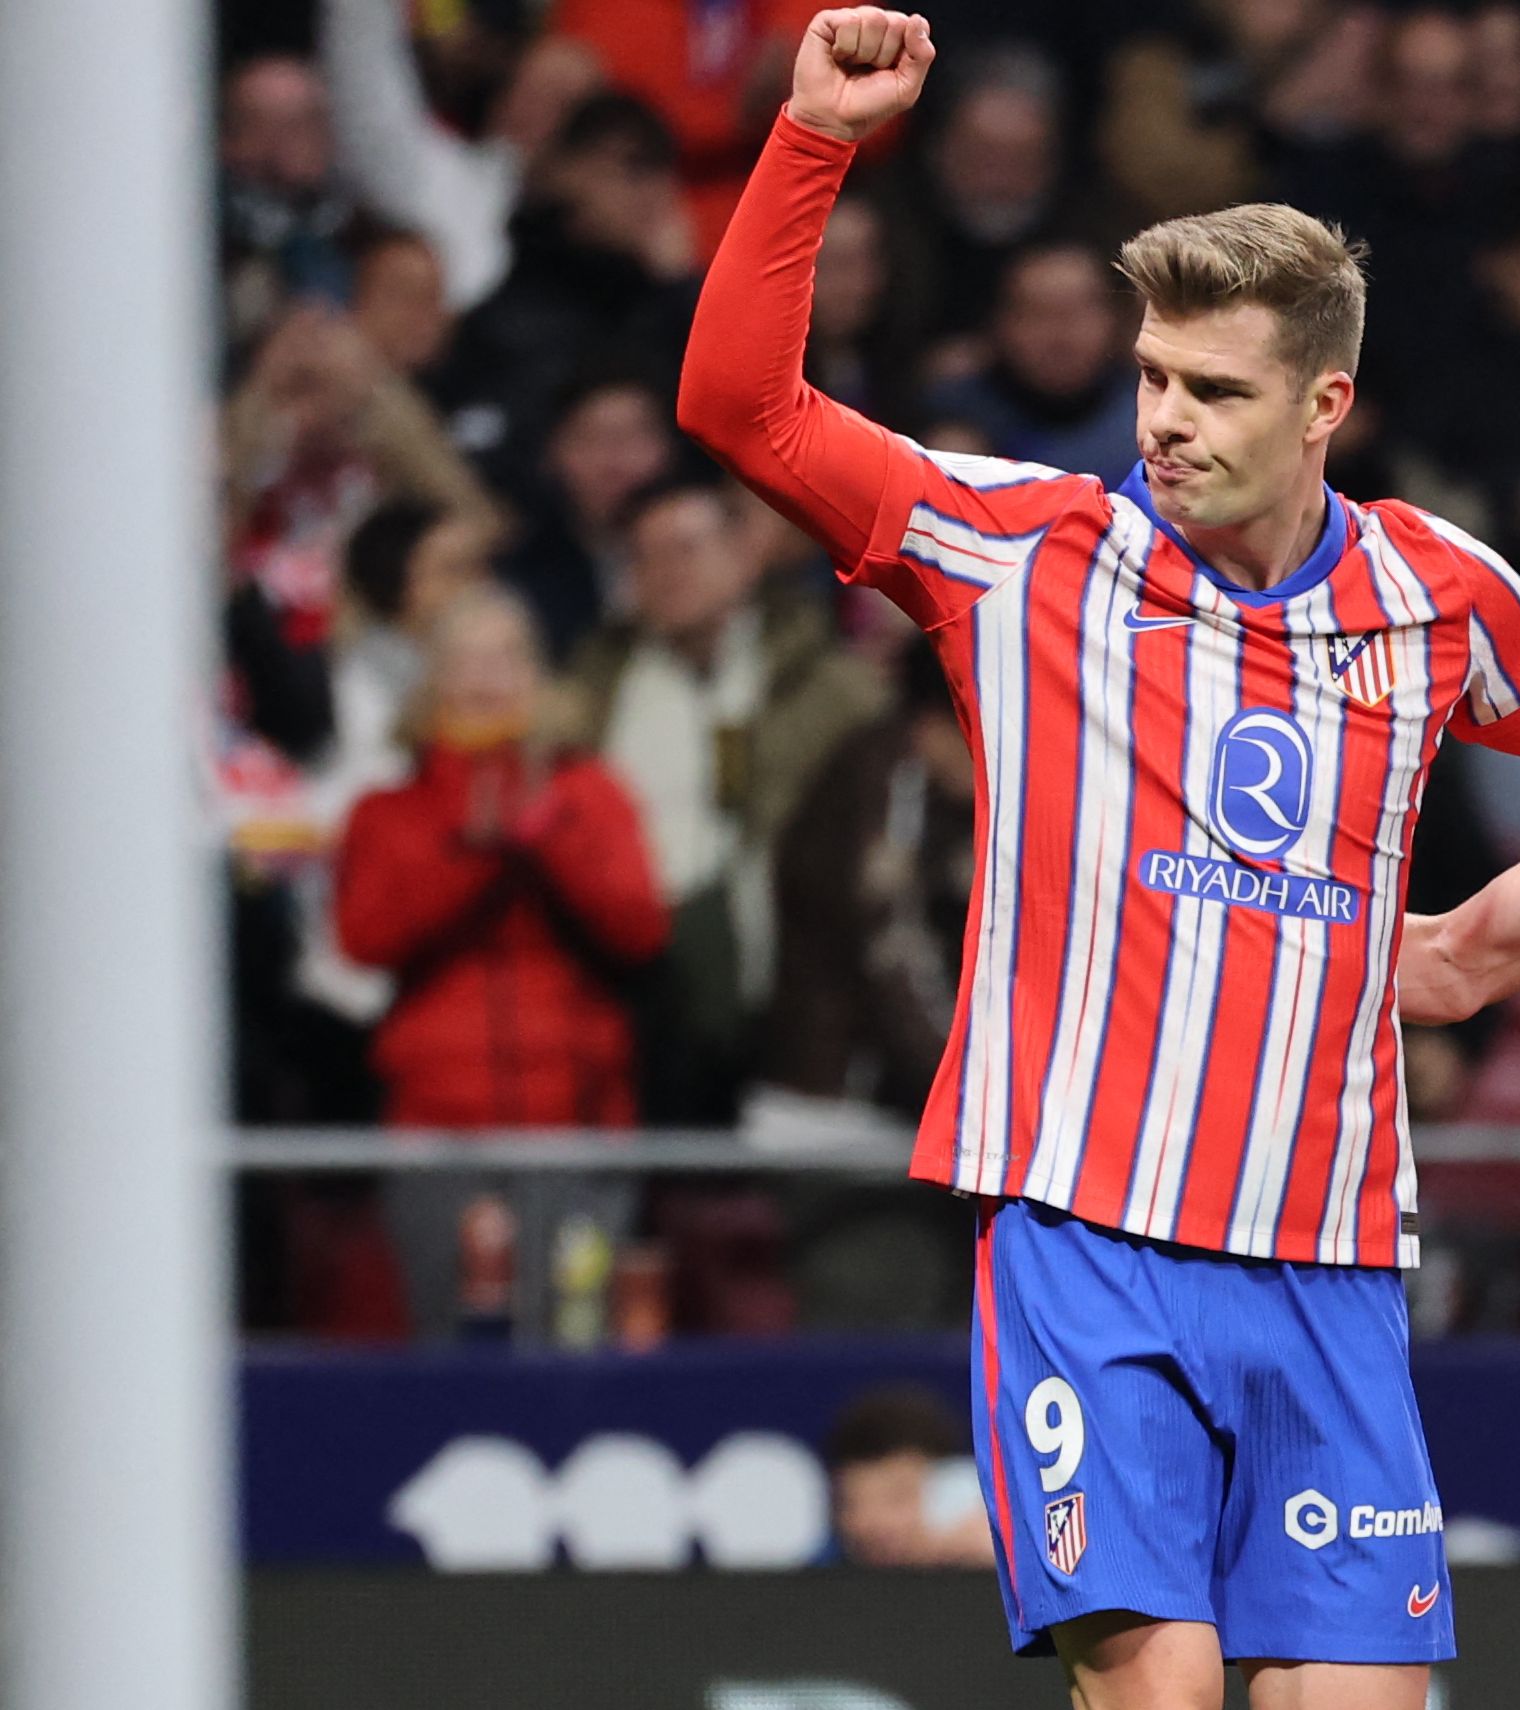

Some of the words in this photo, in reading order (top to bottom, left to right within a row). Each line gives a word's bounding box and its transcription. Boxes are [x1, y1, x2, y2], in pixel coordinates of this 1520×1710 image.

[1149, 853, 1288, 909] RIYADH
[1296, 882, 1352, 920] AIR
[1025, 1376, 1084, 1491] 9
